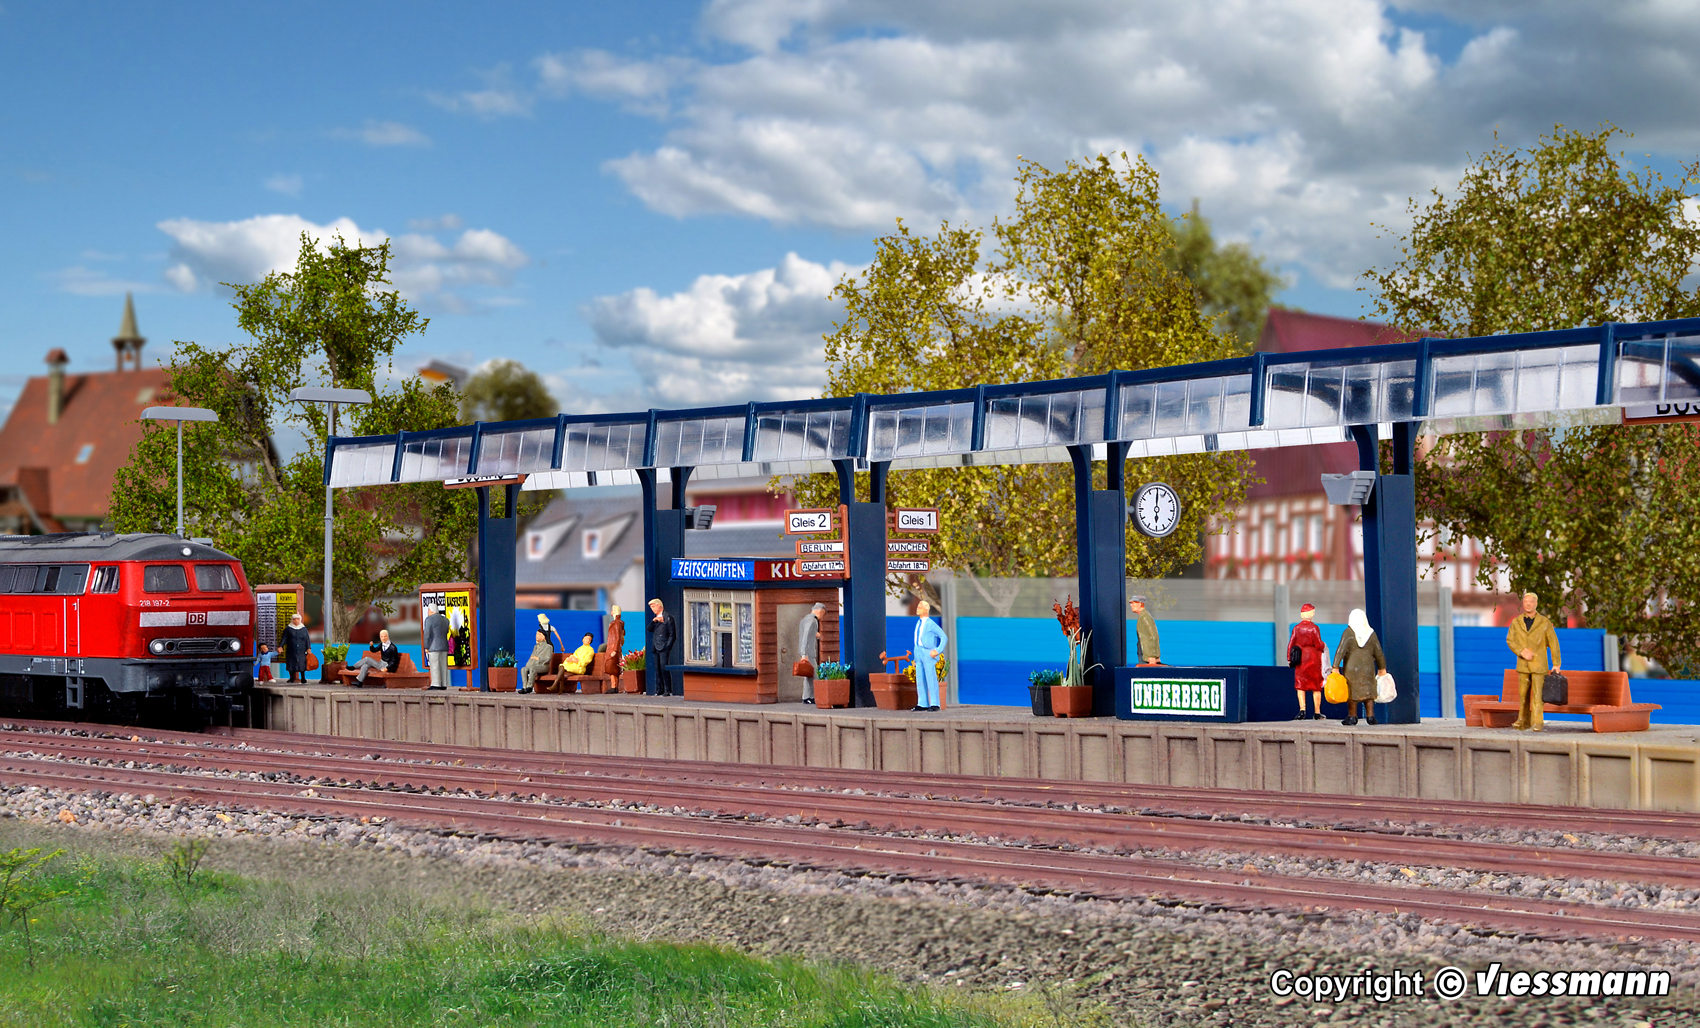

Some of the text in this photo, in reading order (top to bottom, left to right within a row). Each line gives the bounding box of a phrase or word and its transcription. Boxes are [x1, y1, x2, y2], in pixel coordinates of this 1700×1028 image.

[791, 513, 827, 528] Gleis 2
[901, 512, 932, 526] Gleis 1
[802, 544, 833, 553] BERLIN
[677, 561, 746, 579] ZEITSCHRIFTEN
[802, 562, 827, 571] Abfahrt
[888, 561, 912, 569] Abfahrt
[139, 599, 171, 608] 218 197-2
[189, 613, 204, 624] DB
[1133, 682, 1220, 710] UNDERBERG
